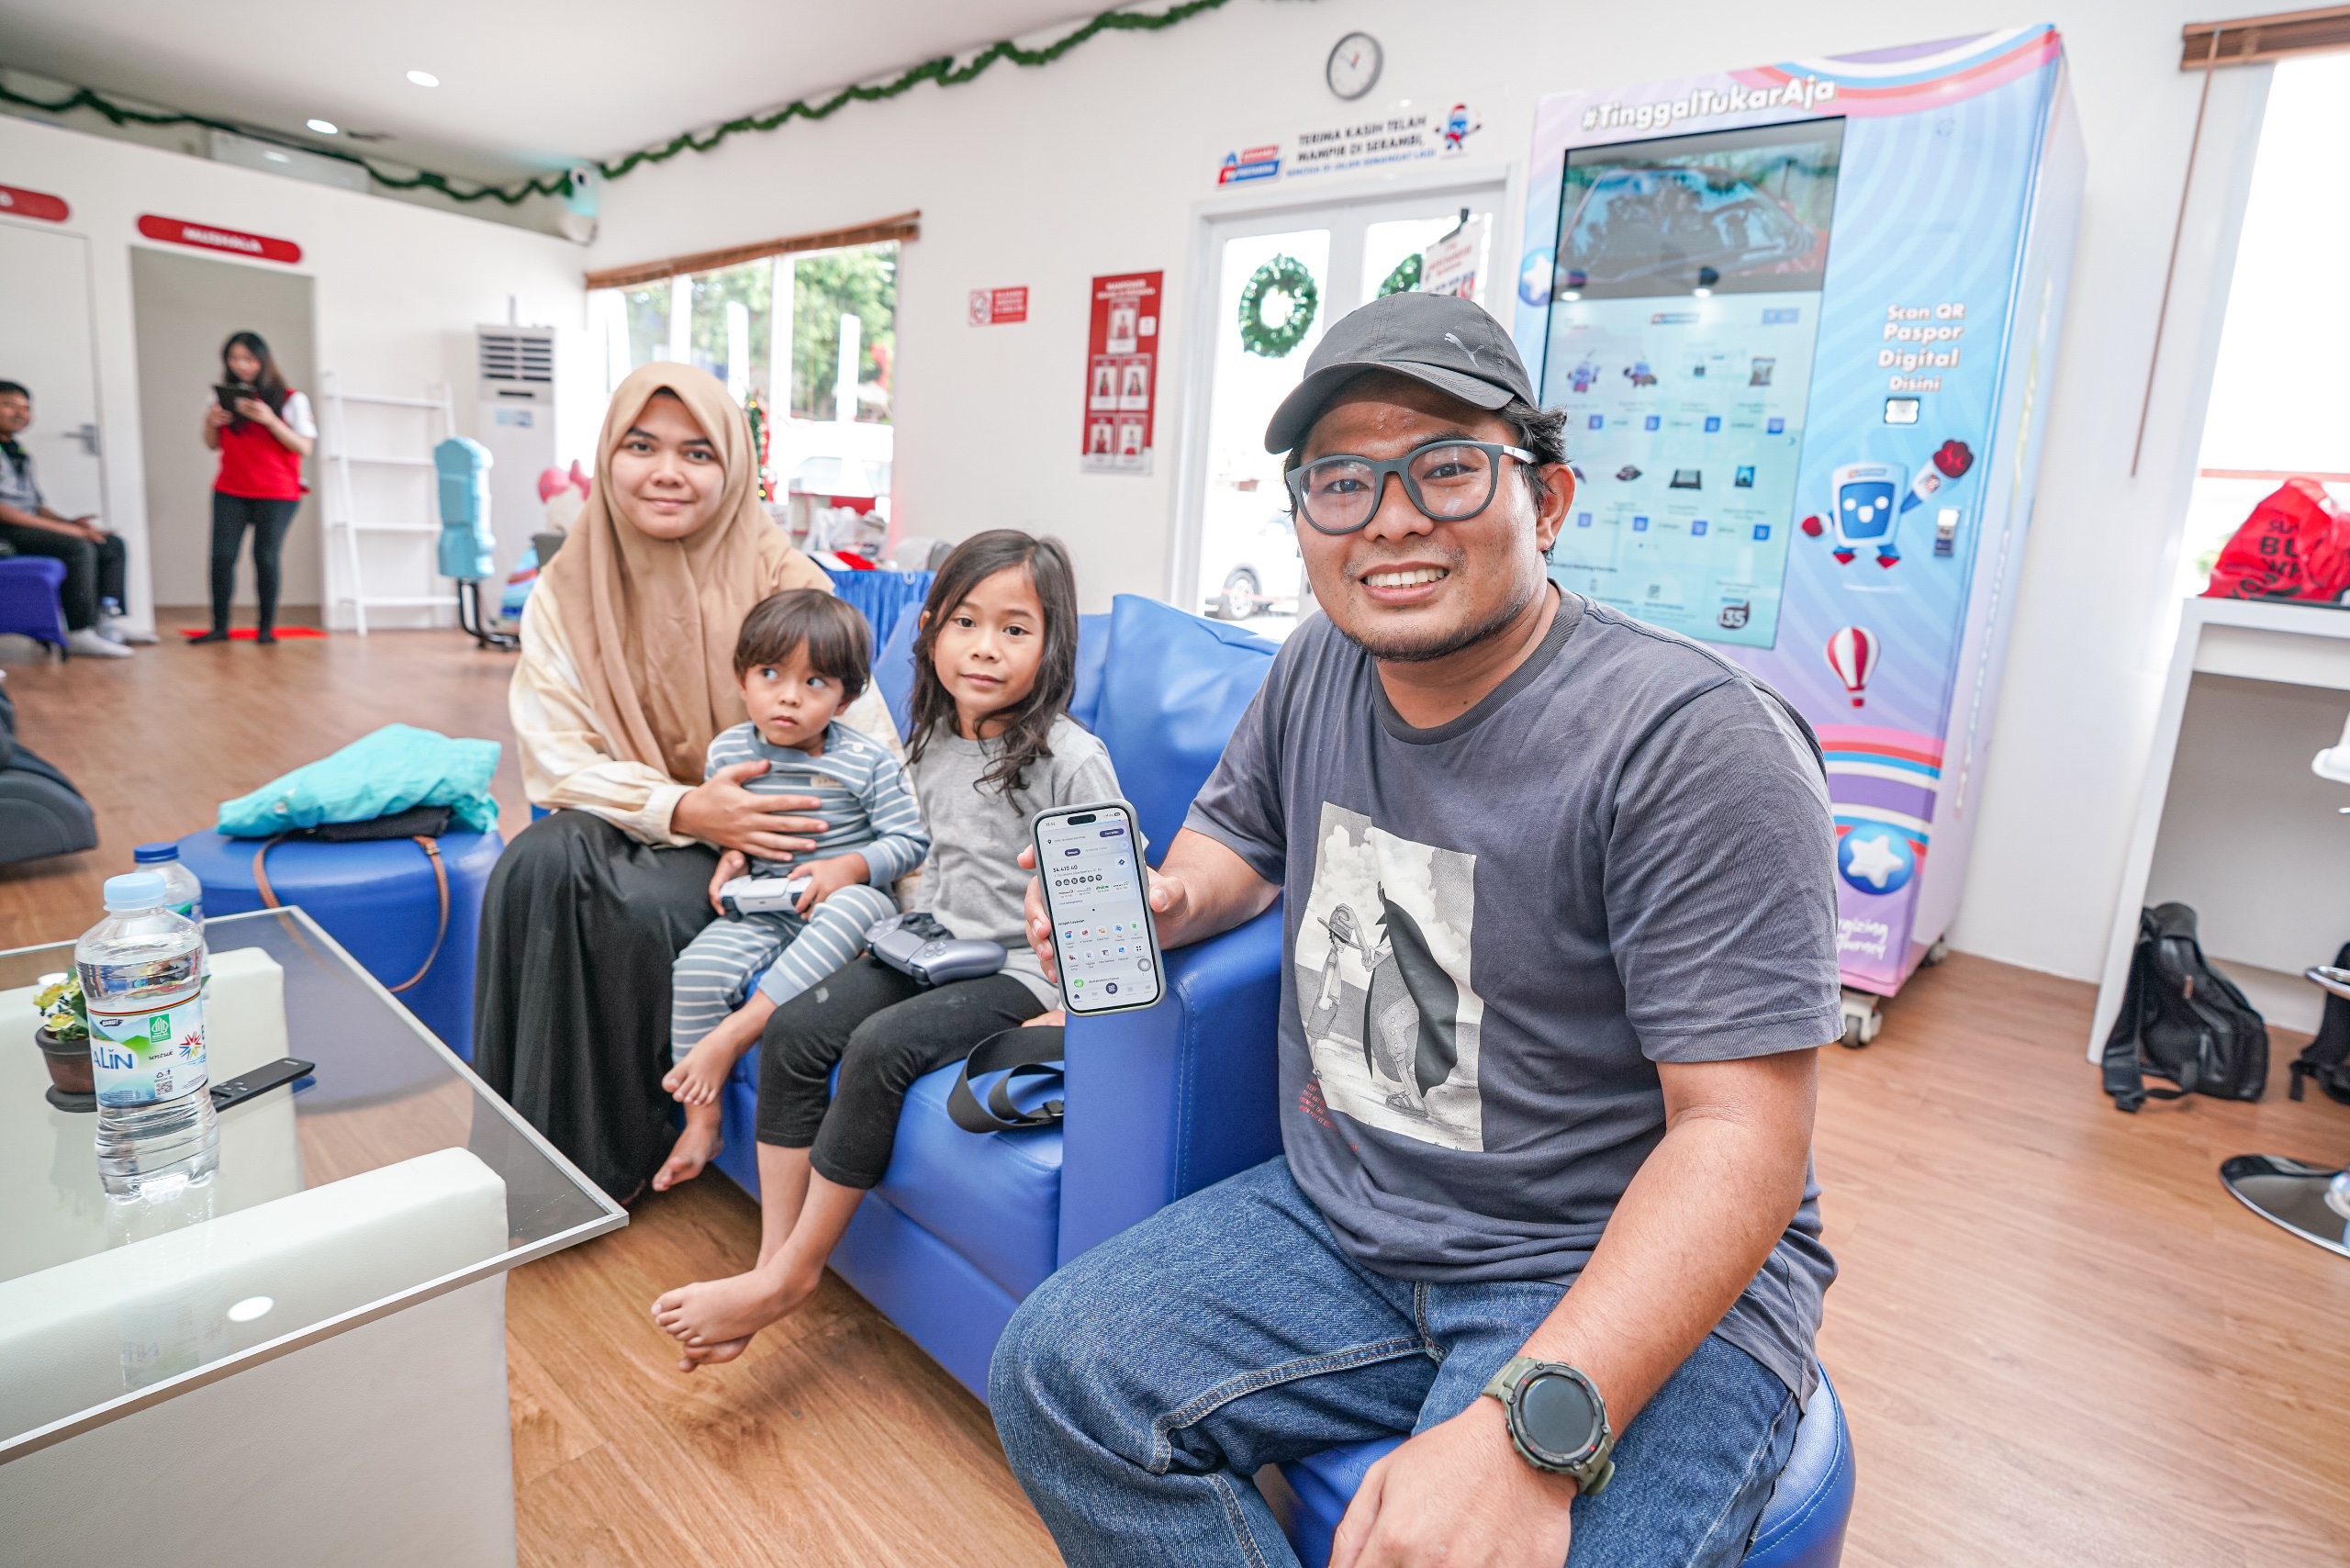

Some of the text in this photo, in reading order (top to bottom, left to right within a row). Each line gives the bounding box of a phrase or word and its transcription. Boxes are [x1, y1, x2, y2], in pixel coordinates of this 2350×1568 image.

[1582, 74, 1836, 131] #TinggalTukarAja
[1345, 123, 1384, 139] KASIH
[1387, 115, 1427, 130] TELAH
[1886, 302, 1966, 321] Scan QR
[1883, 322, 1965, 346] Paspor
[1878, 347, 1961, 373] Digital
[1889, 375, 1942, 391] Disini
[1838, 917, 1889, 944] rgizing
[149, 1049, 173, 1060] untuk
